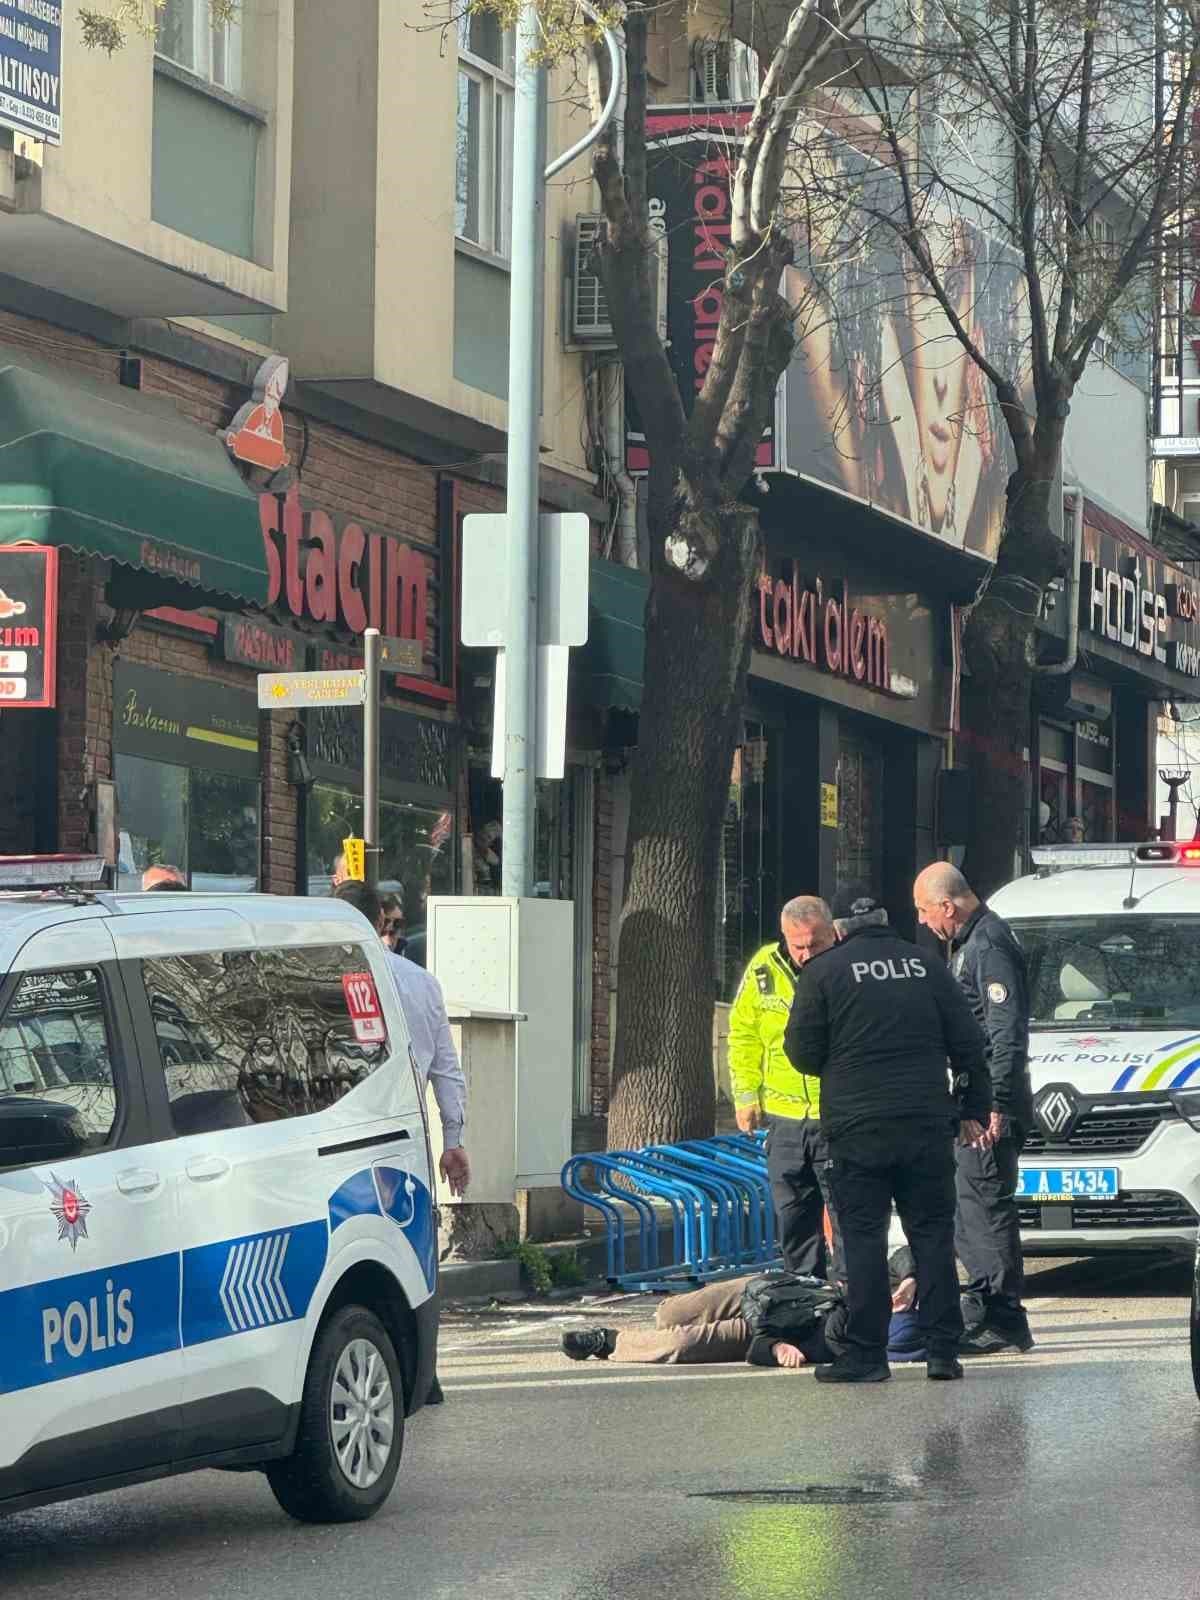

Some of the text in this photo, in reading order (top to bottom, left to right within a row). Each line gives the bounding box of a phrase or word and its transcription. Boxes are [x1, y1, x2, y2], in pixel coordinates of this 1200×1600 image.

[347, 980, 376, 1013] 112
[1038, 1170, 1050, 1193] A
[1061, 1170, 1109, 1194] 5434
[42, 1278, 135, 1365] POLİS
